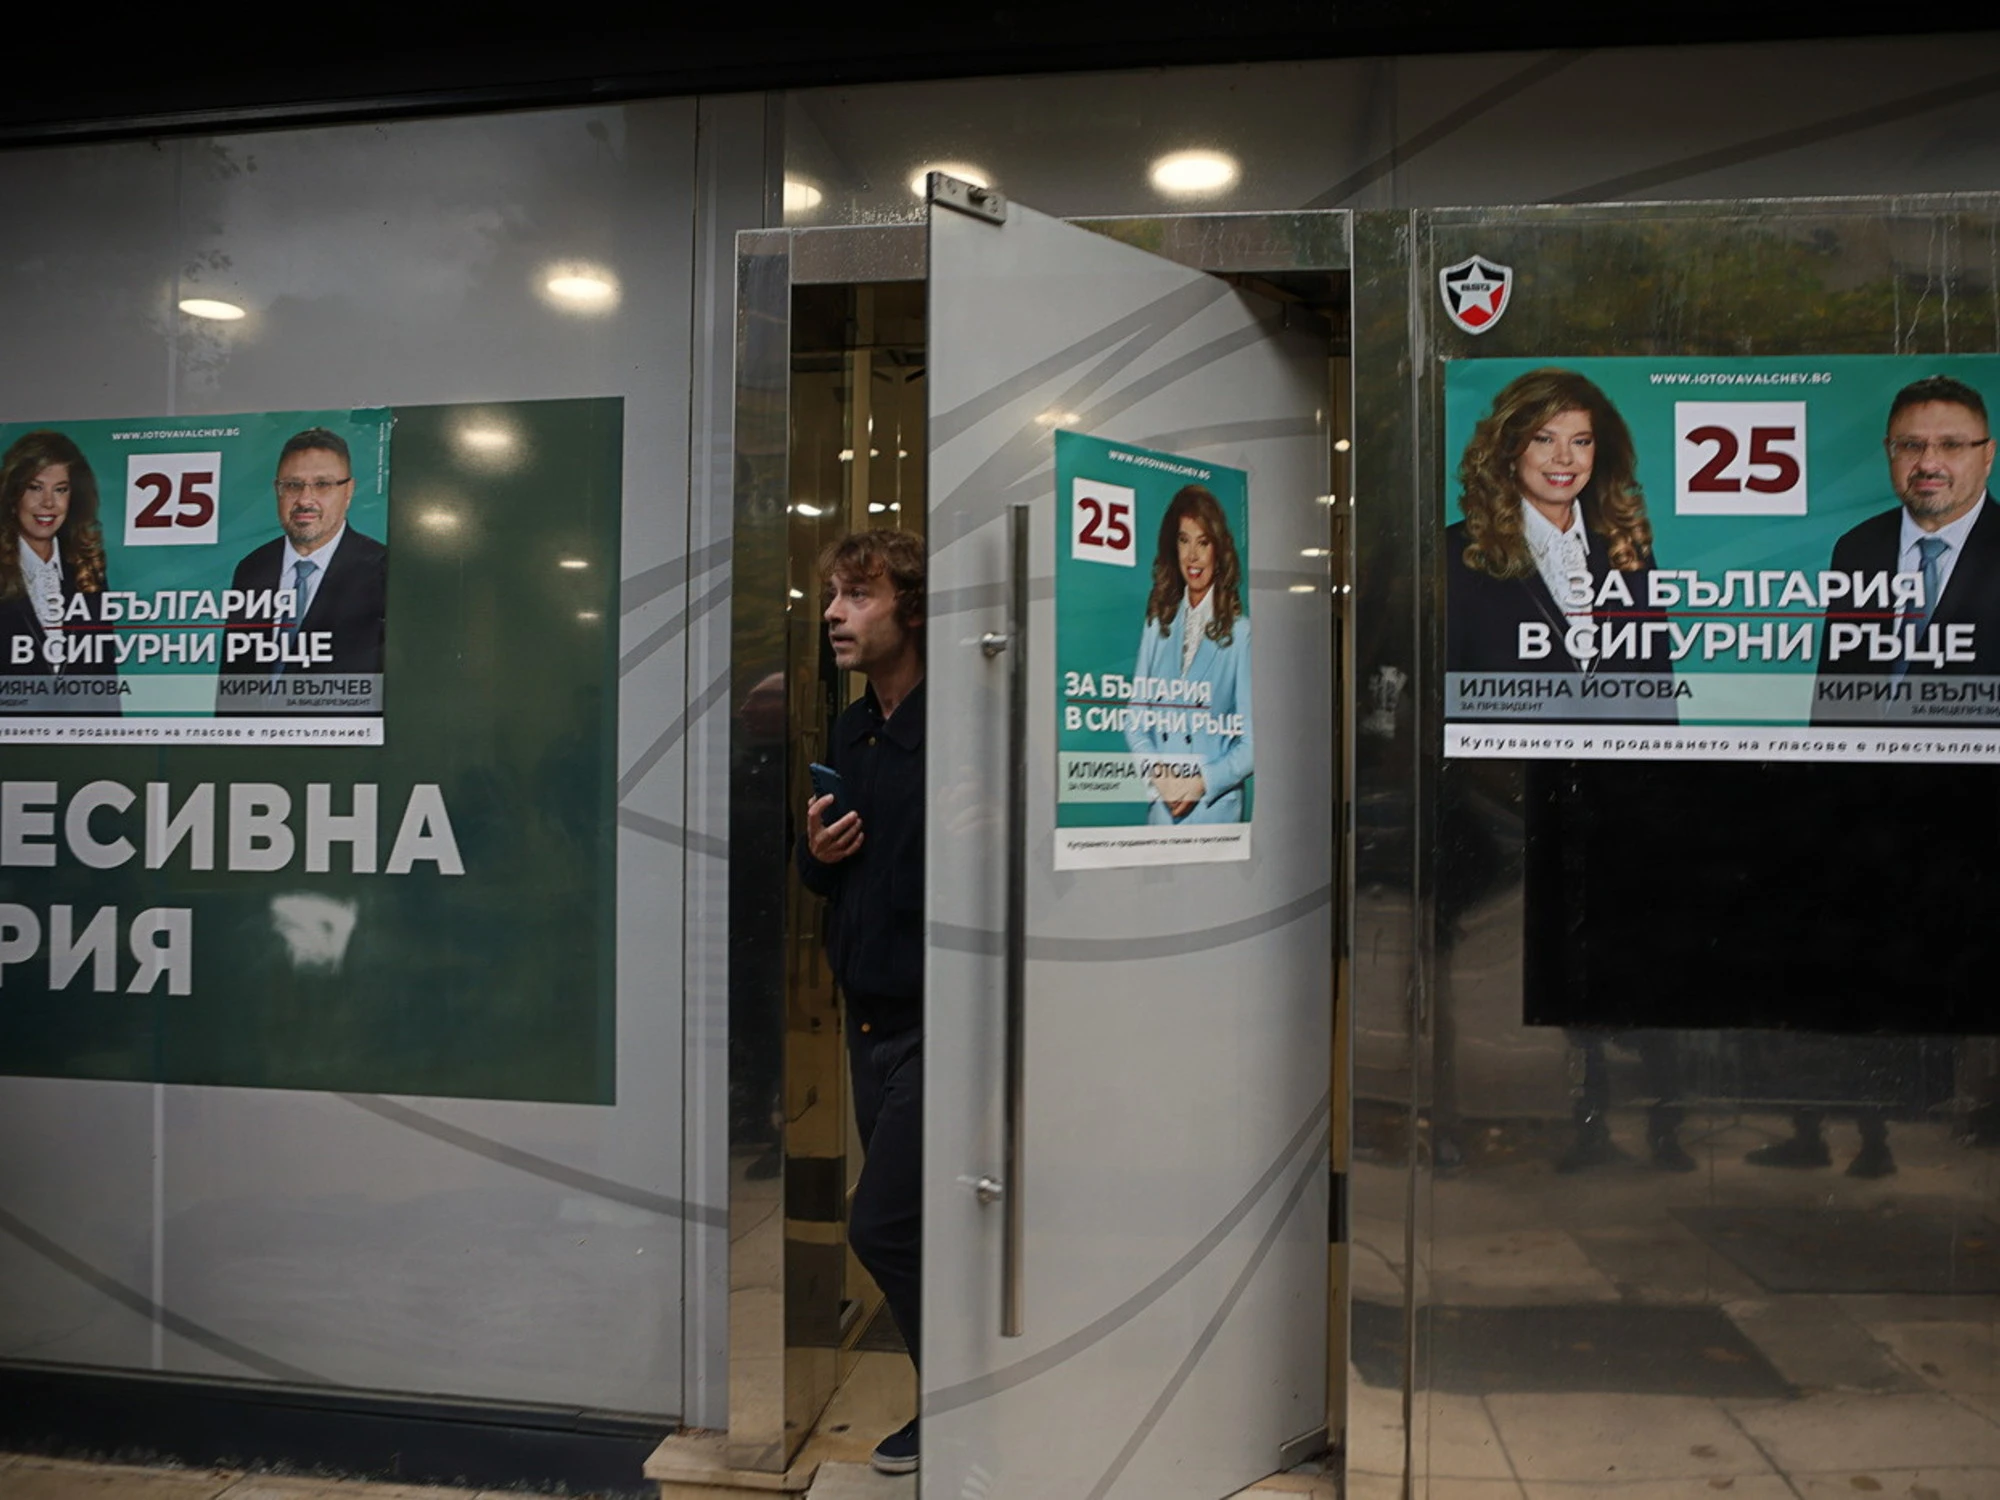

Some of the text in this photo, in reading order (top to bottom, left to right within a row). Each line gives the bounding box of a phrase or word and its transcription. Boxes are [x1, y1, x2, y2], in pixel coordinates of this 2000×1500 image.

[1650, 371, 1833, 386] WWW.IOTOVAVALCHEV.BG
[112, 427, 240, 441] WWW.IOTOVAVALCHEV.BG
[1684, 424, 1802, 495] 25
[133, 471, 216, 529] 25
[1077, 496, 1131, 551] 25
[1564, 569, 1926, 609] ЗА БЪЛГАРИЯ
[46, 588, 298, 623] ЗА БЪЛГАРИЯ
[10, 631, 334, 668] В СИГУРНИ РЪЦЕ
[1517, 621, 1977, 669] В СИГУРНИ РЪЦЕ
[53, 676, 132, 696] ЙОТОВА
[219, 679, 372, 696] КИРИЛ ВЪЛЧЕВ
[1064, 671, 1213, 703] ЗА БЪЛГАРИЯ
[1459, 676, 1693, 699] ИЛИЯНА ЙОТОВА
[1818, 681, 2000, 702] КИРИЛ ВЪЛЧ
[1460, 702, 1543, 712] ЗА ПРЕЗИДЕНТ
[69, 727, 159, 738] продаването
[165, 728, 180, 737] на
[186, 728, 242, 737] гласове
[248, 729, 255, 737] е
[261, 727, 372, 738] престъпление!
[1064, 706, 1246, 738] В СИГУРНИ РЪЦЕ
[1460, 735, 2000, 755] Купуването и продаването на гласове е престъплен
[1068, 758, 1202, 780] ИЛИЯНА ЙОТОВА
[1, 780, 466, 876] ЕСИВНА
